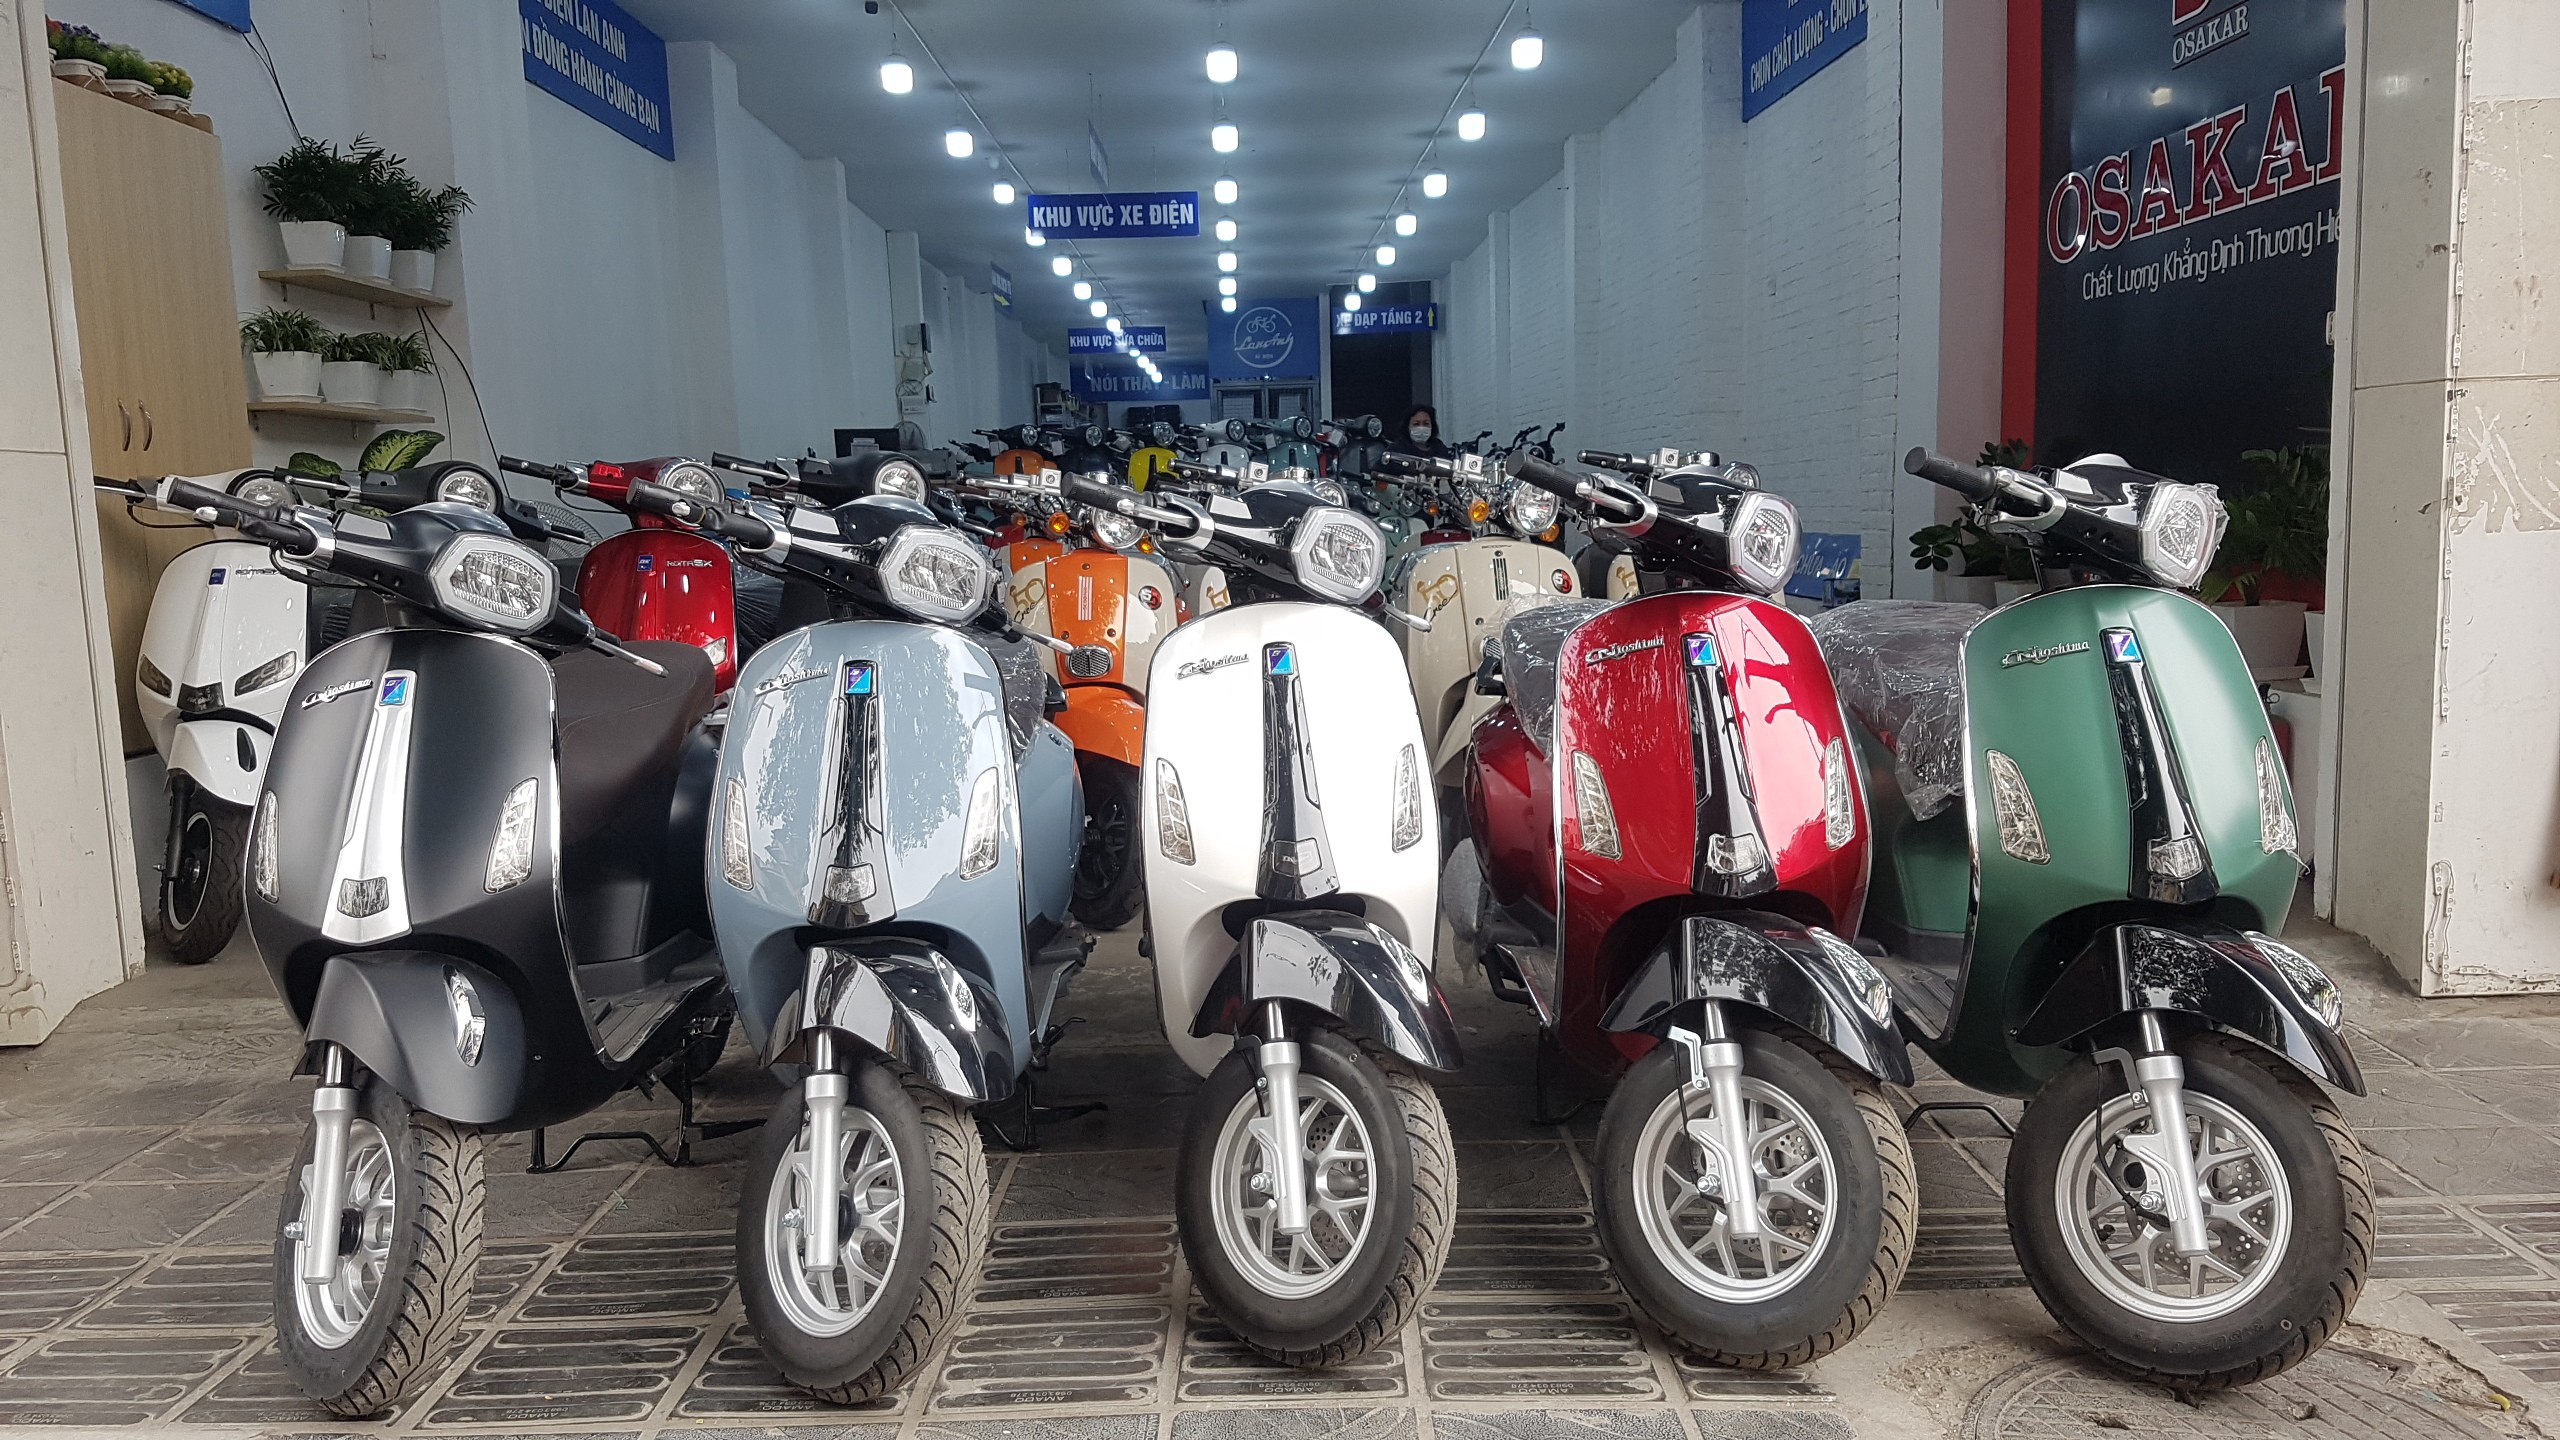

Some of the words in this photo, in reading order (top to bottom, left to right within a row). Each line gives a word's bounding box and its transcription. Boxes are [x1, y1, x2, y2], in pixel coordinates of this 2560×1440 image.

[575, 0, 600, 45] LAN
[603, 18, 627, 63] ANH
[2173, 5, 2249, 64] OSAKAR
[1751, 51, 1771, 93] CHỌN
[1772, 26, 1792, 78] CHẤT
[1794, 9, 1824, 61] LƯỢNG
[532, 15, 570, 78] ĐỒNG
[570, 48, 605, 100] HÀNH
[605, 70, 638, 120] CÙNG
[637, 92, 660, 134] BẠN
[1033, 206, 1072, 228] KHU
[1077, 203, 1114, 231] VỰC
[1120, 204, 1144, 226] XE
[1149, 199, 1194, 230] ĐIỆN
[2083, 263, 2113, 300] Chất
[2117, 262, 2160, 294] Lượng
[2163, 237, 2208, 282] Khẳng
[2211, 233, 2244, 274] Định
[1354, 312, 1378, 329] ĐẠP
[1415, 311, 1423, 324] 2
[1069, 335, 1090, 348] KHU
[1092, 334, 1112, 349] VỰC
[1137, 332, 1165, 346] CHỮA
[1091, 373, 1118, 393] NÓI
[1171, 371, 1206, 390] LÀM
[1014, 1395, 1065, 1403] AMADO
[507, 1412, 558, 1420] AMADO
